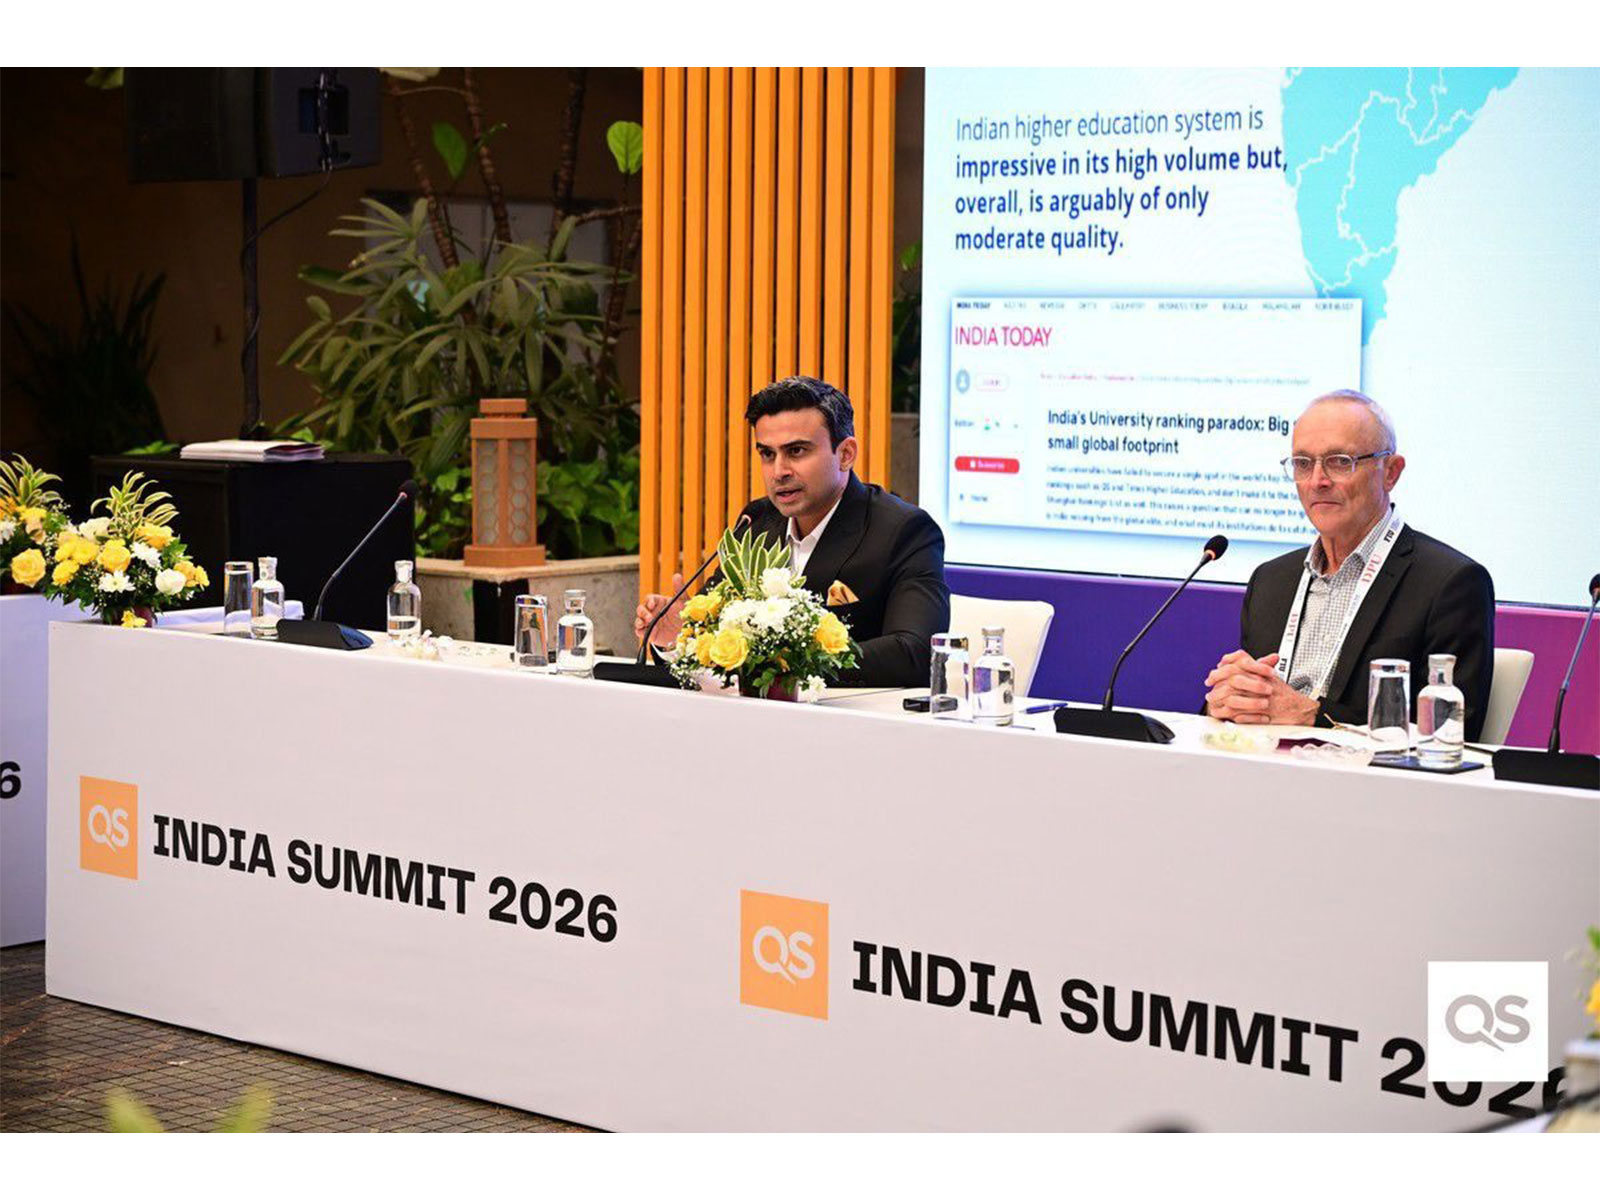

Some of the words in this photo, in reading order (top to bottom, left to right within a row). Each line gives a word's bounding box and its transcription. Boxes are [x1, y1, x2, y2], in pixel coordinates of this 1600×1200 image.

[956, 117, 1009, 141] Indian
[1015, 116, 1072, 146] higher
[1077, 110, 1168, 137] education
[1175, 109, 1242, 141] system
[1249, 105, 1264, 131] is
[956, 153, 1056, 184] impressive
[1062, 152, 1079, 175] in
[1086, 150, 1109, 174] its
[1116, 149, 1157, 180] high
[1164, 146, 1240, 172] volume
[1247, 145, 1288, 173] but,
[955, 189, 1023, 217] overall,
[1029, 189, 1044, 213] is
[1049, 187, 1134, 220] arguably
[1140, 186, 1160, 210] of
[1165, 185, 1209, 216] only
[955, 226, 1045, 250] moderate
[1051, 225, 1124, 255] quality.
[955, 326, 999, 347] INDIA
[1001, 326, 1053, 347] TODAY
[1048, 410, 1086, 425] India's
[1089, 411, 1154, 430] University
[1156, 413, 1204, 433] ranking
[1207, 415, 1265, 433] paradox:
[1268, 416, 1290, 435] Big
[1048, 435, 1079, 450] small
[1082, 436, 1119, 454] global
[1122, 438, 1179, 455] footprint
[1361, 554, 1382, 583] DPU
[0, 761, 21, 799] 6
[87, 803, 130, 852] QS
[153, 814, 276, 878] INDIA
[287, 839, 475, 914] SUMMIT
[488, 876, 618, 943] 2026
[752, 925, 815, 985] QS
[852, 940, 1042, 1025] INDIA
[1060, 978, 1359, 1082] SUMMIT
